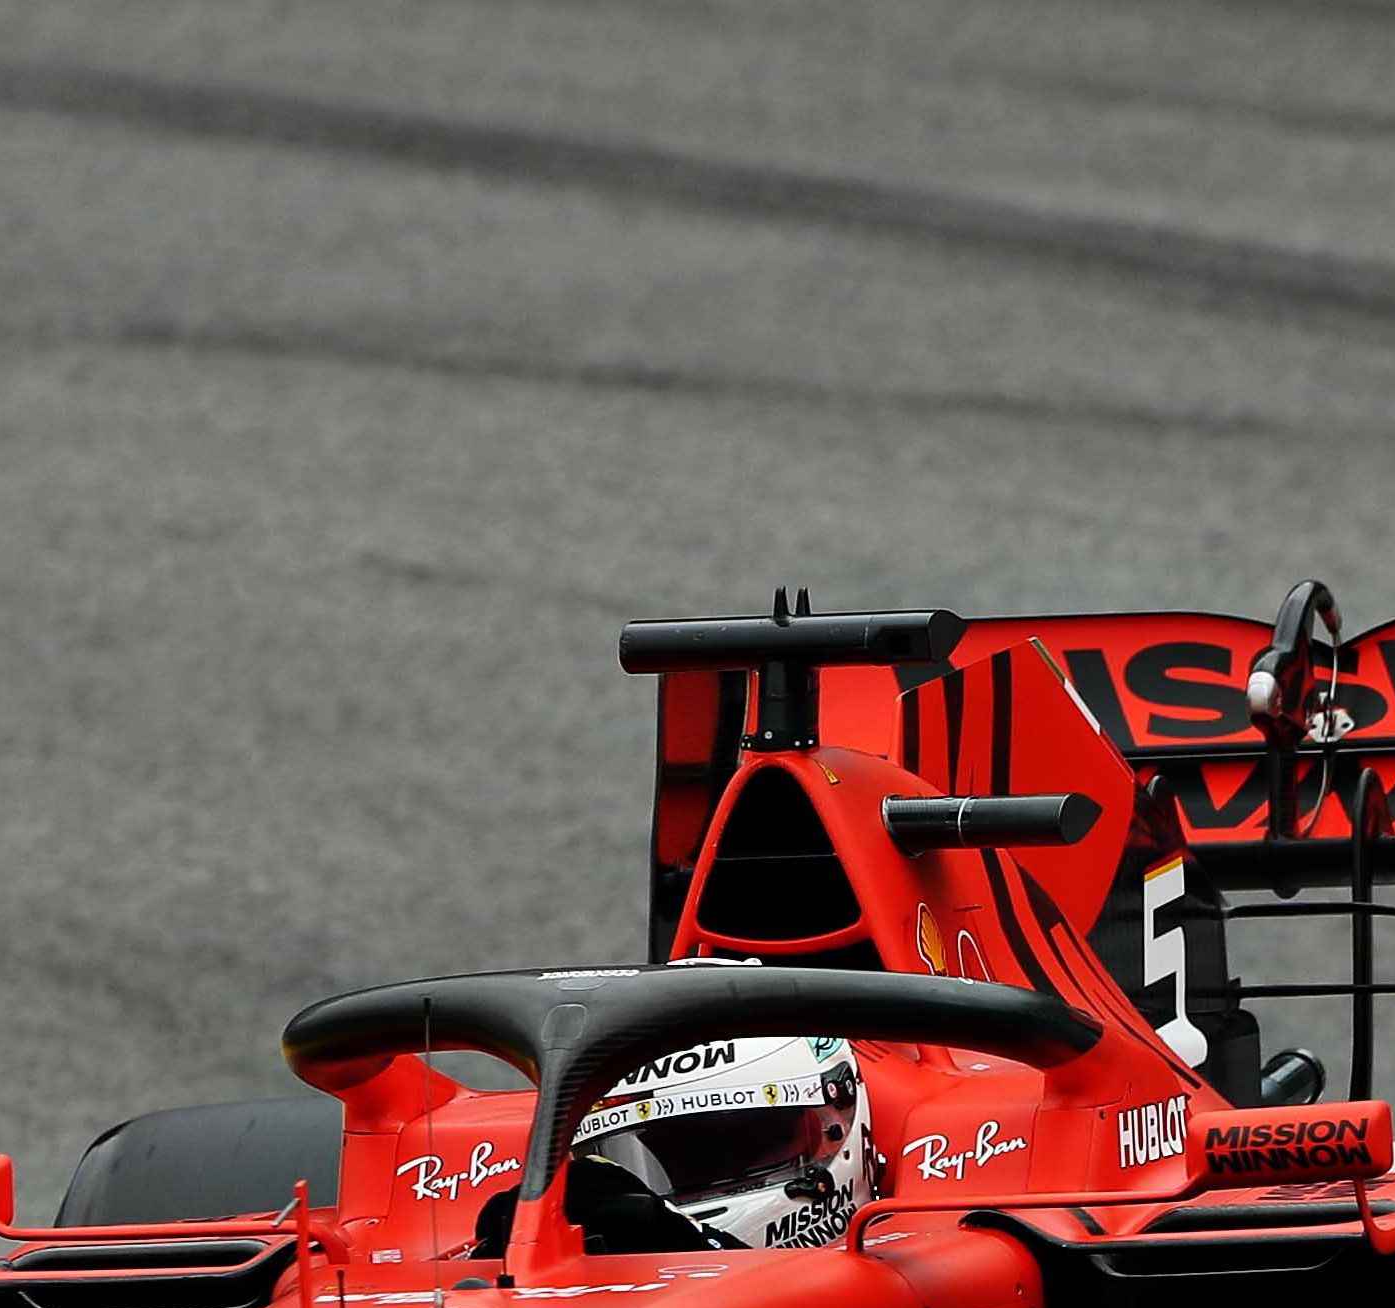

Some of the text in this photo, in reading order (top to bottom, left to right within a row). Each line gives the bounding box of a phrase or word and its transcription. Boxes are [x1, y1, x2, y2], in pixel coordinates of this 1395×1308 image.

[1144, 858, 1208, 1069] 5
[681, 1090, 755, 1110] HUBLOT
[903, 1120, 1028, 1181] Ray-Ban
[1117, 1094, 1188, 1169] HUBLOT
[1206, 1118, 1369, 1151] MISSION
[1207, 1143, 1373, 1174] WINNOW
[396, 1141, 522, 1200] Ray-Ban
[765, 1177, 854, 1248] MISSION
